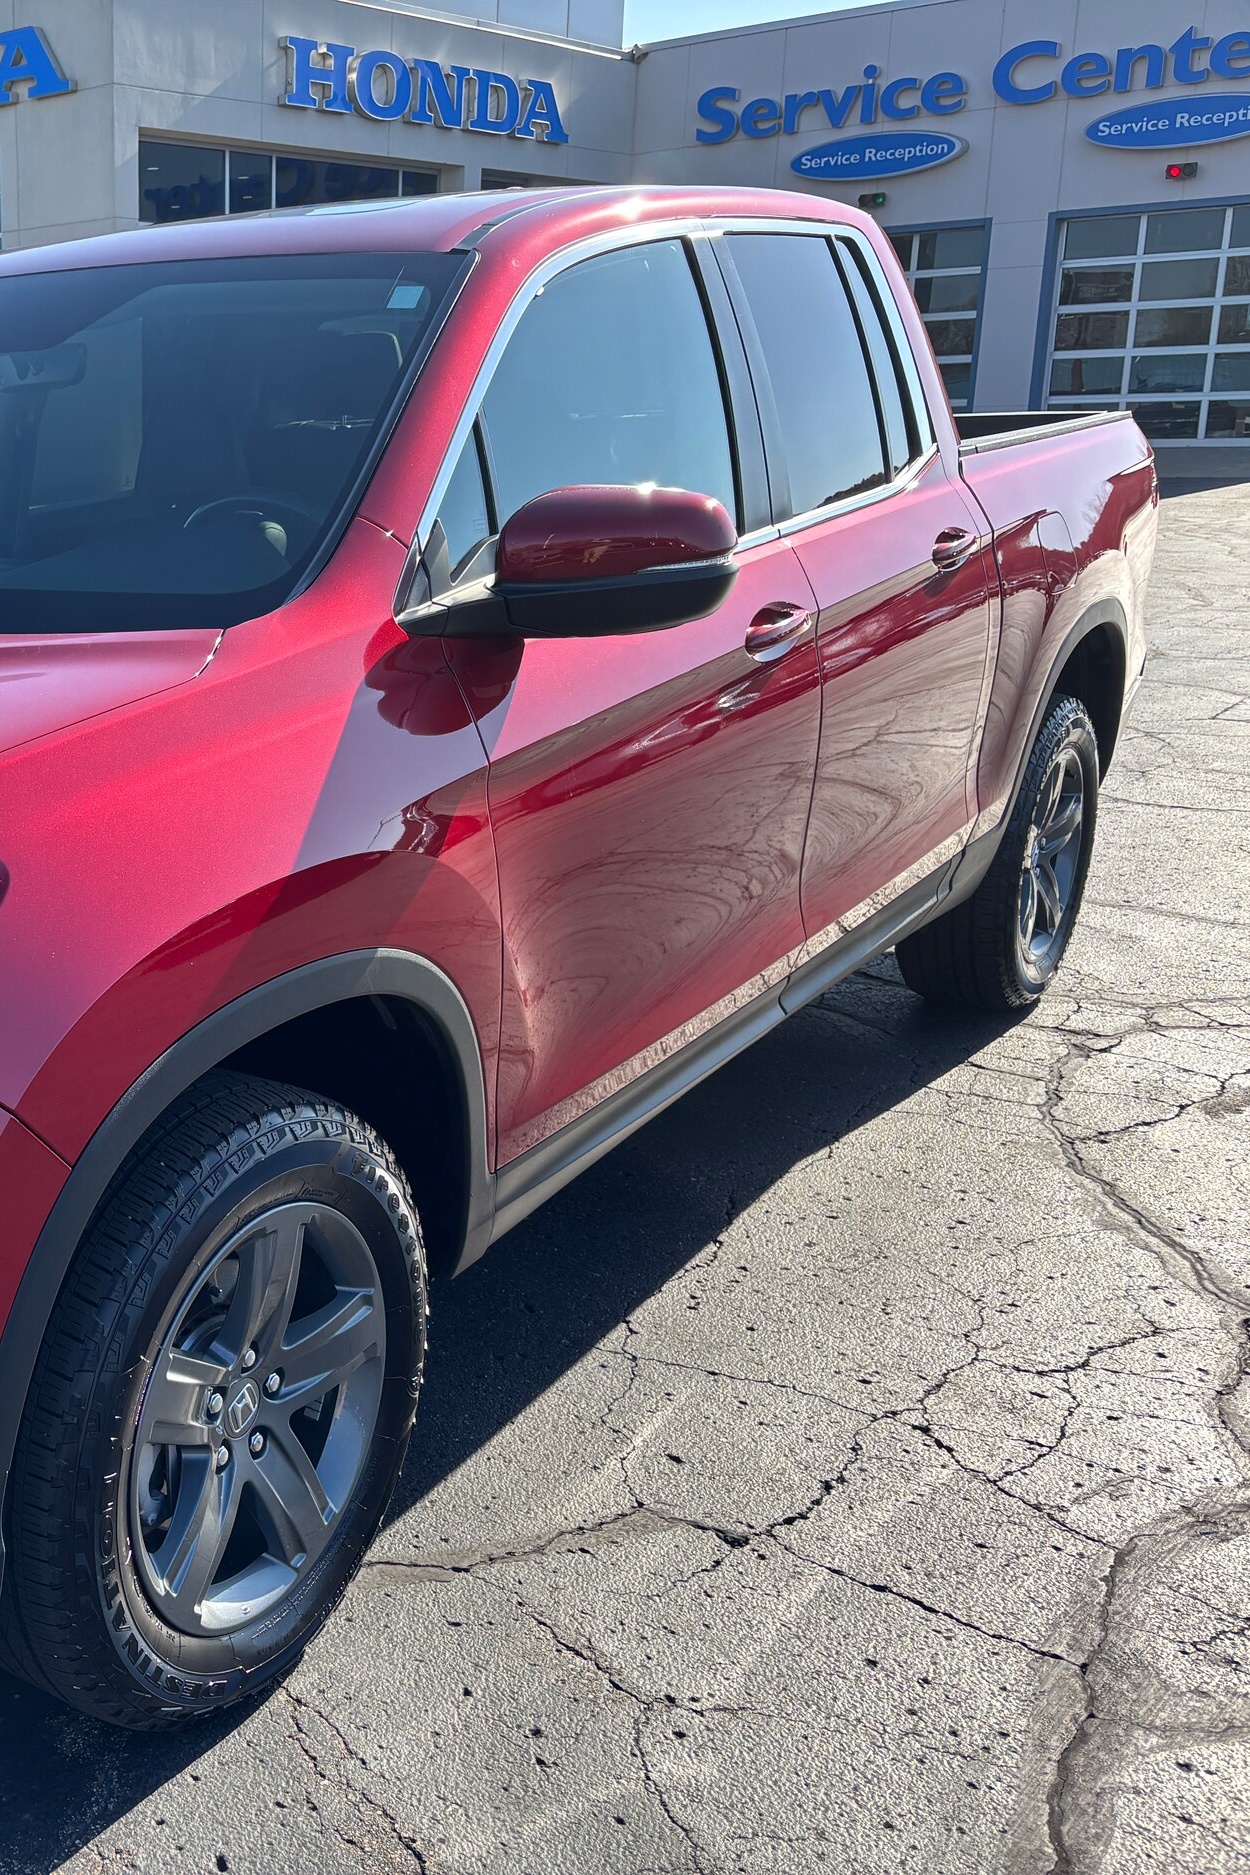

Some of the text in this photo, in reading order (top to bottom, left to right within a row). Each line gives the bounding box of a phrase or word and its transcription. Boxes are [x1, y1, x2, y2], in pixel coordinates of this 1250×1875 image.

[280, 35, 568, 144] HONDA
[696, 64, 967, 144] Service
[1097, 117, 1170, 137] Service
[800, 142, 949, 169] Service Reception
